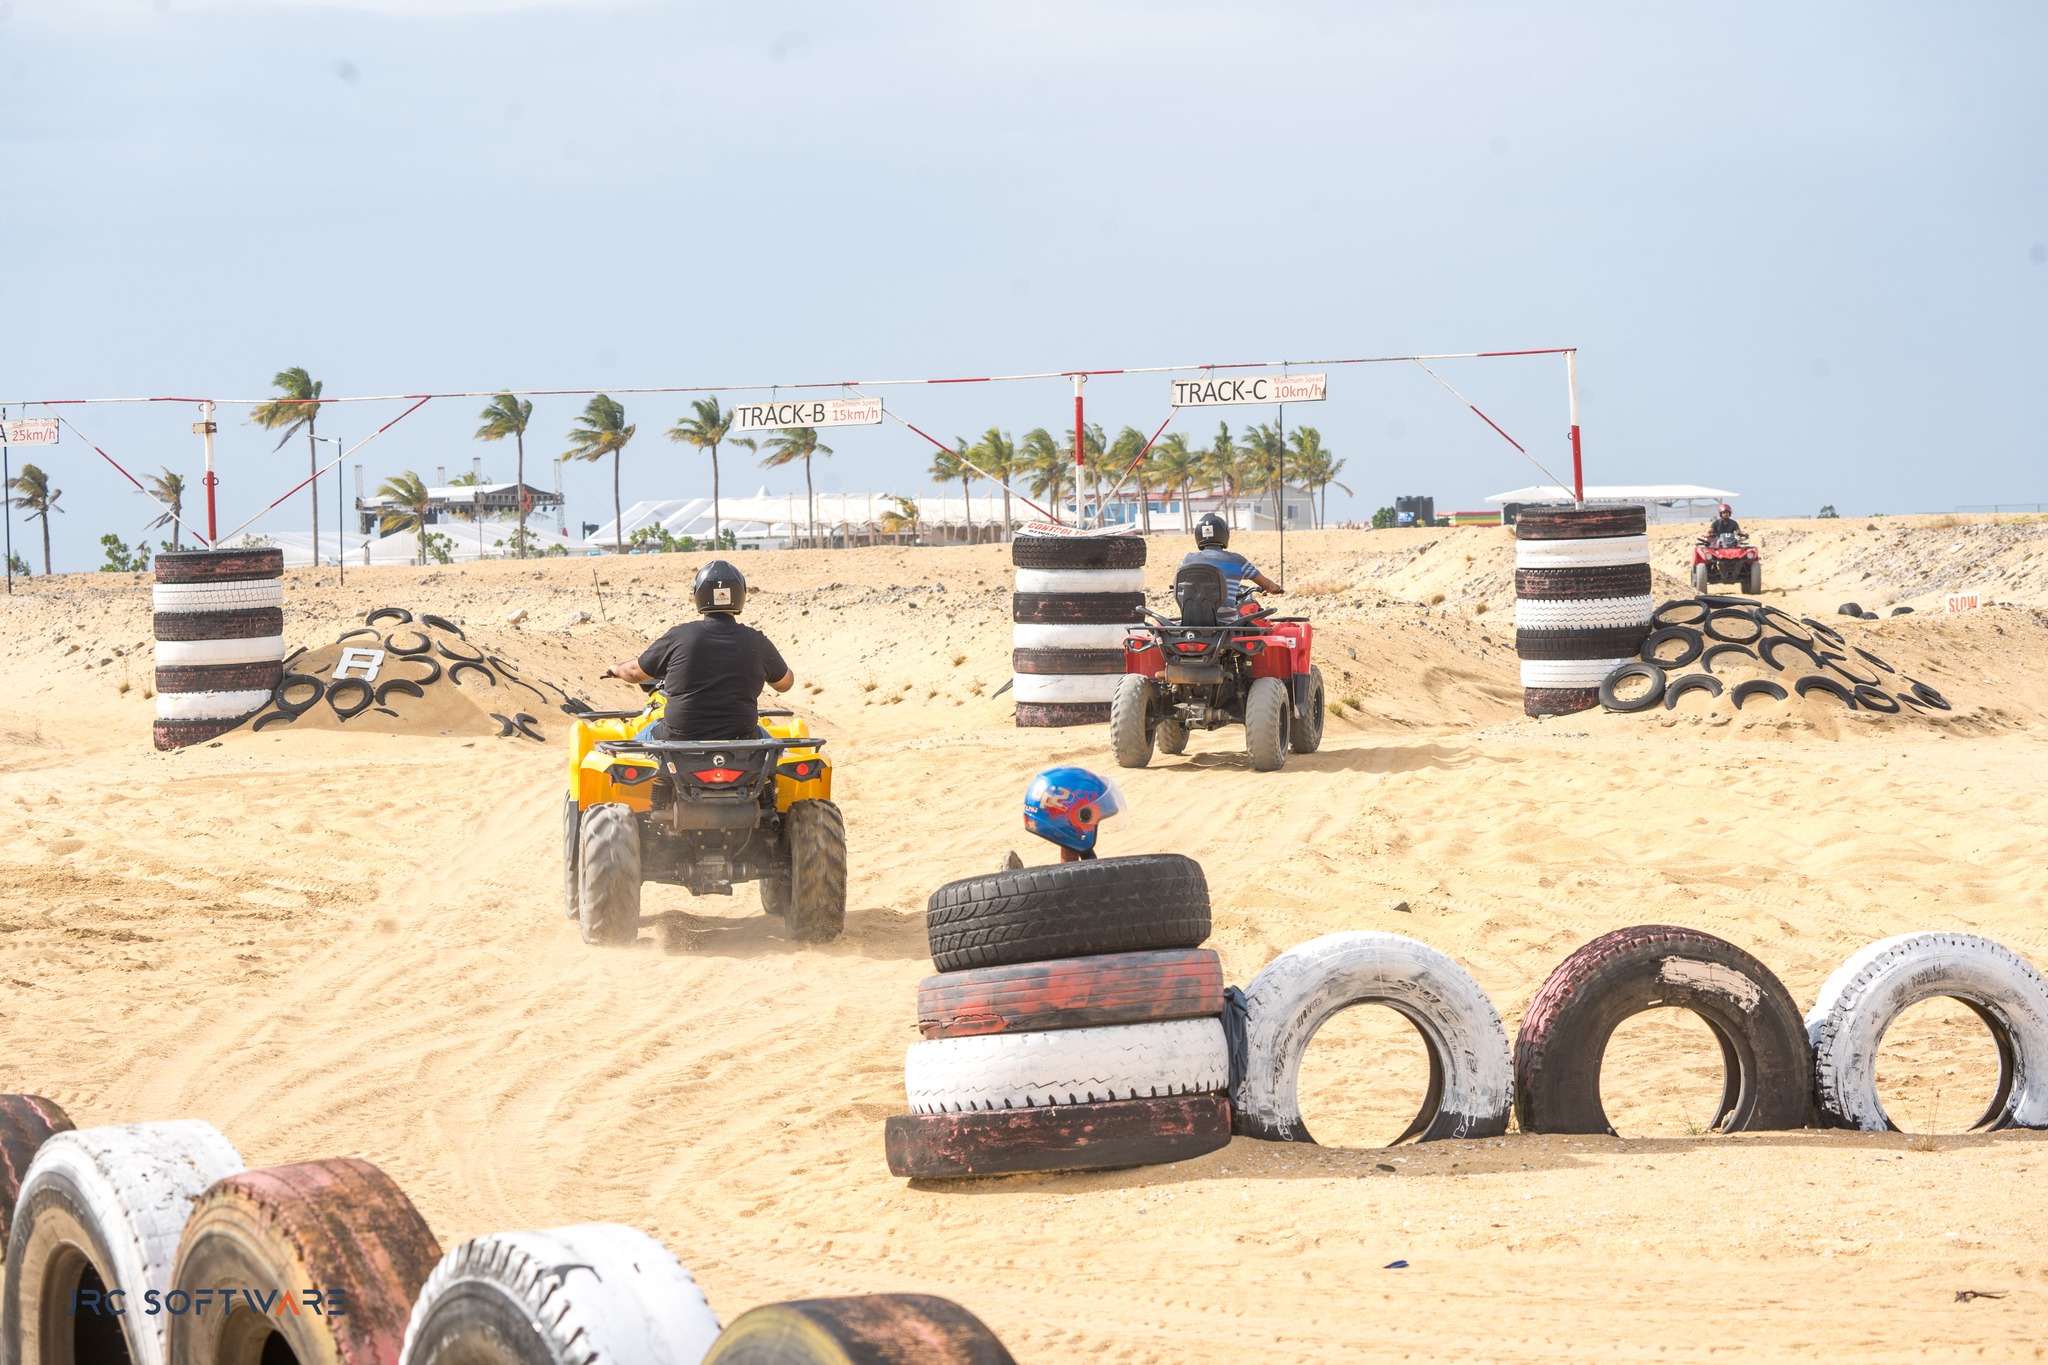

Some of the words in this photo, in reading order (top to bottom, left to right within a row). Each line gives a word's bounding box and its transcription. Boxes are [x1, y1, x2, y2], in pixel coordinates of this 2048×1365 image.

[1175, 379, 1268, 403] TRACK-C
[1274, 386, 1322, 399] 10km/h
[832, 400, 861, 408] Maximum
[738, 403, 826, 427] TRACK-B
[832, 407, 879, 421] 15km/h
[12, 428, 56, 442] 25km/h
[1028, 523, 1073, 536] CONTROL
[1948, 595, 1978, 613] SLOW
